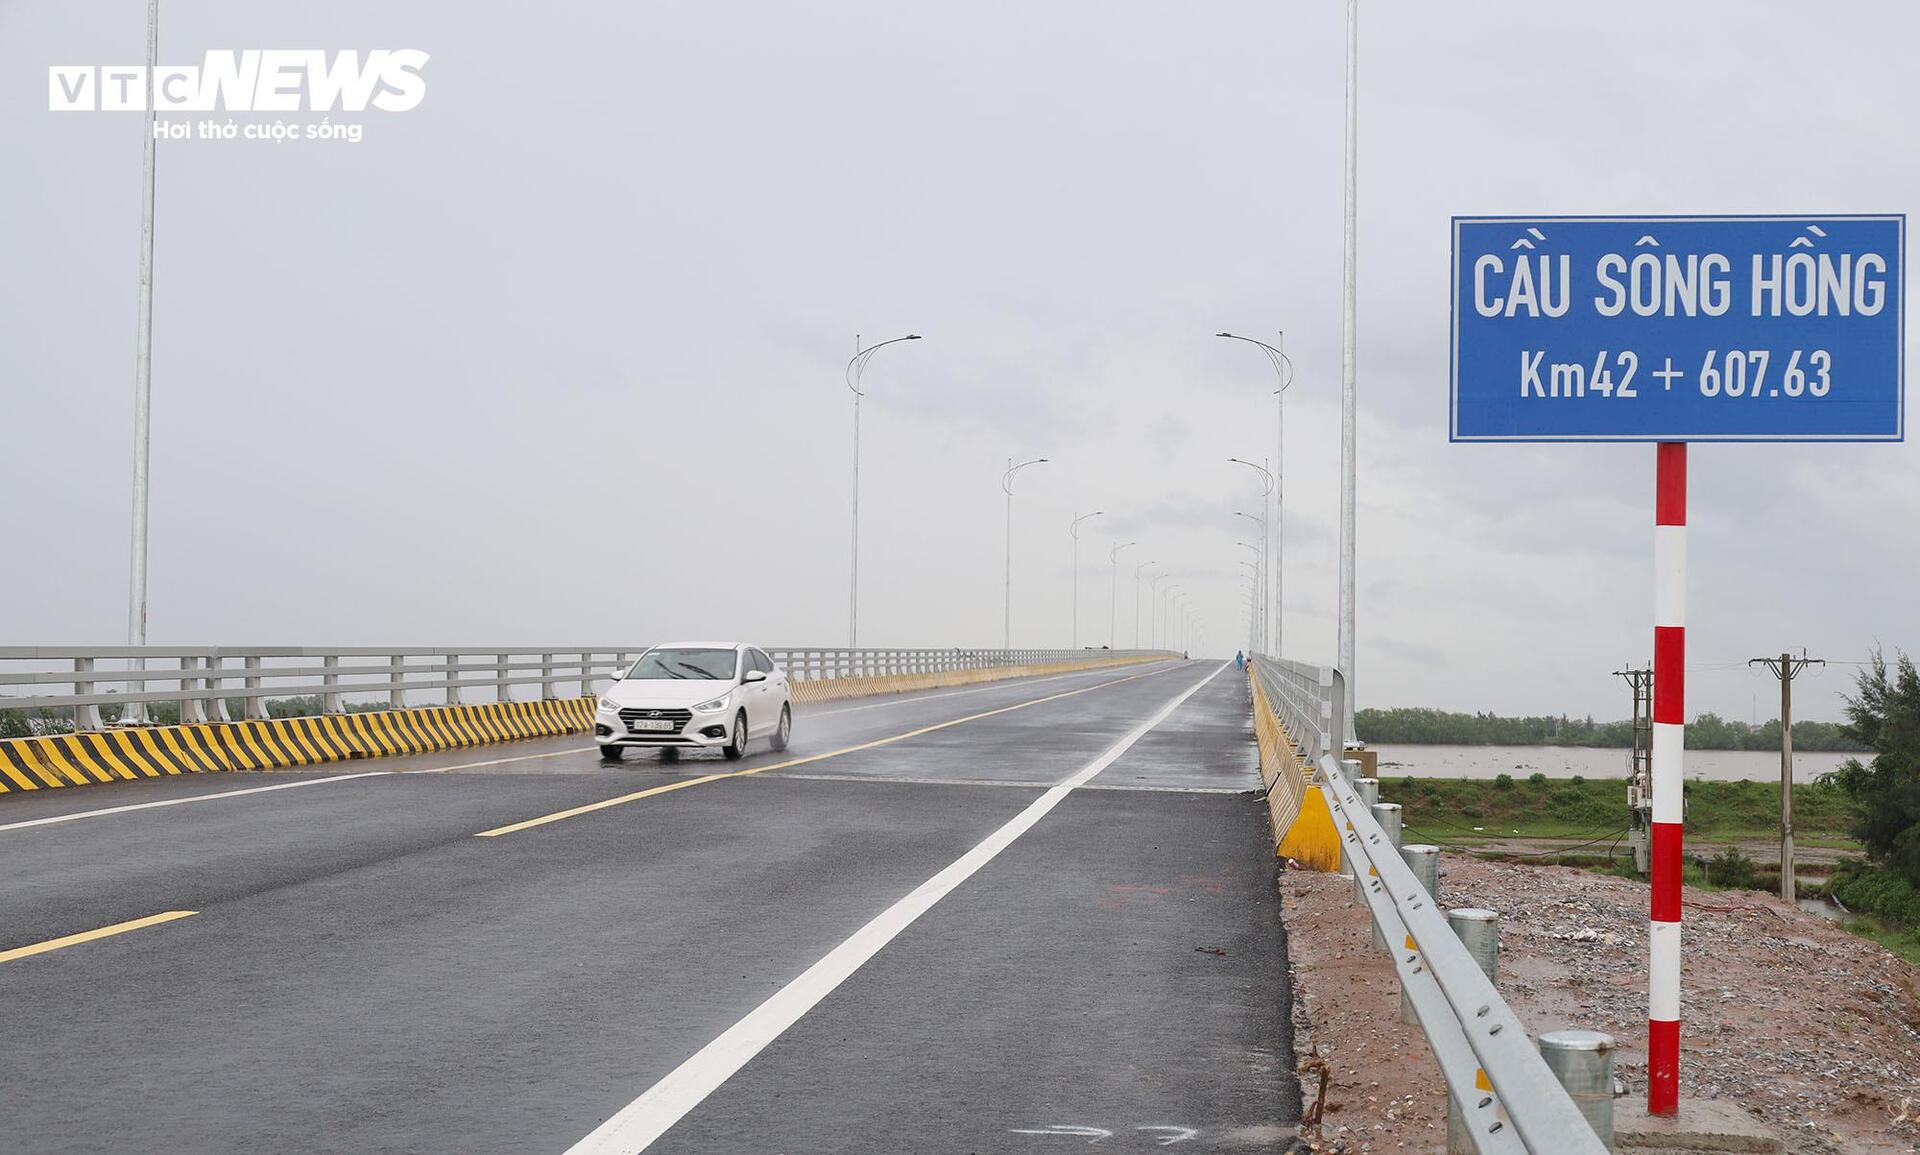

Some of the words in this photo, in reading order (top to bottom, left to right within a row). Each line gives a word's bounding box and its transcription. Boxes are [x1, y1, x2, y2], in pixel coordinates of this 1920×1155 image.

[1474, 227, 1570, 318] CẦU
[1594, 235, 1731, 317] SÔNG
[1751, 225, 1886, 317] HỒNG
[1520, 350, 1638, 398] Km42
[1699, 350, 1831, 397] 607.63
